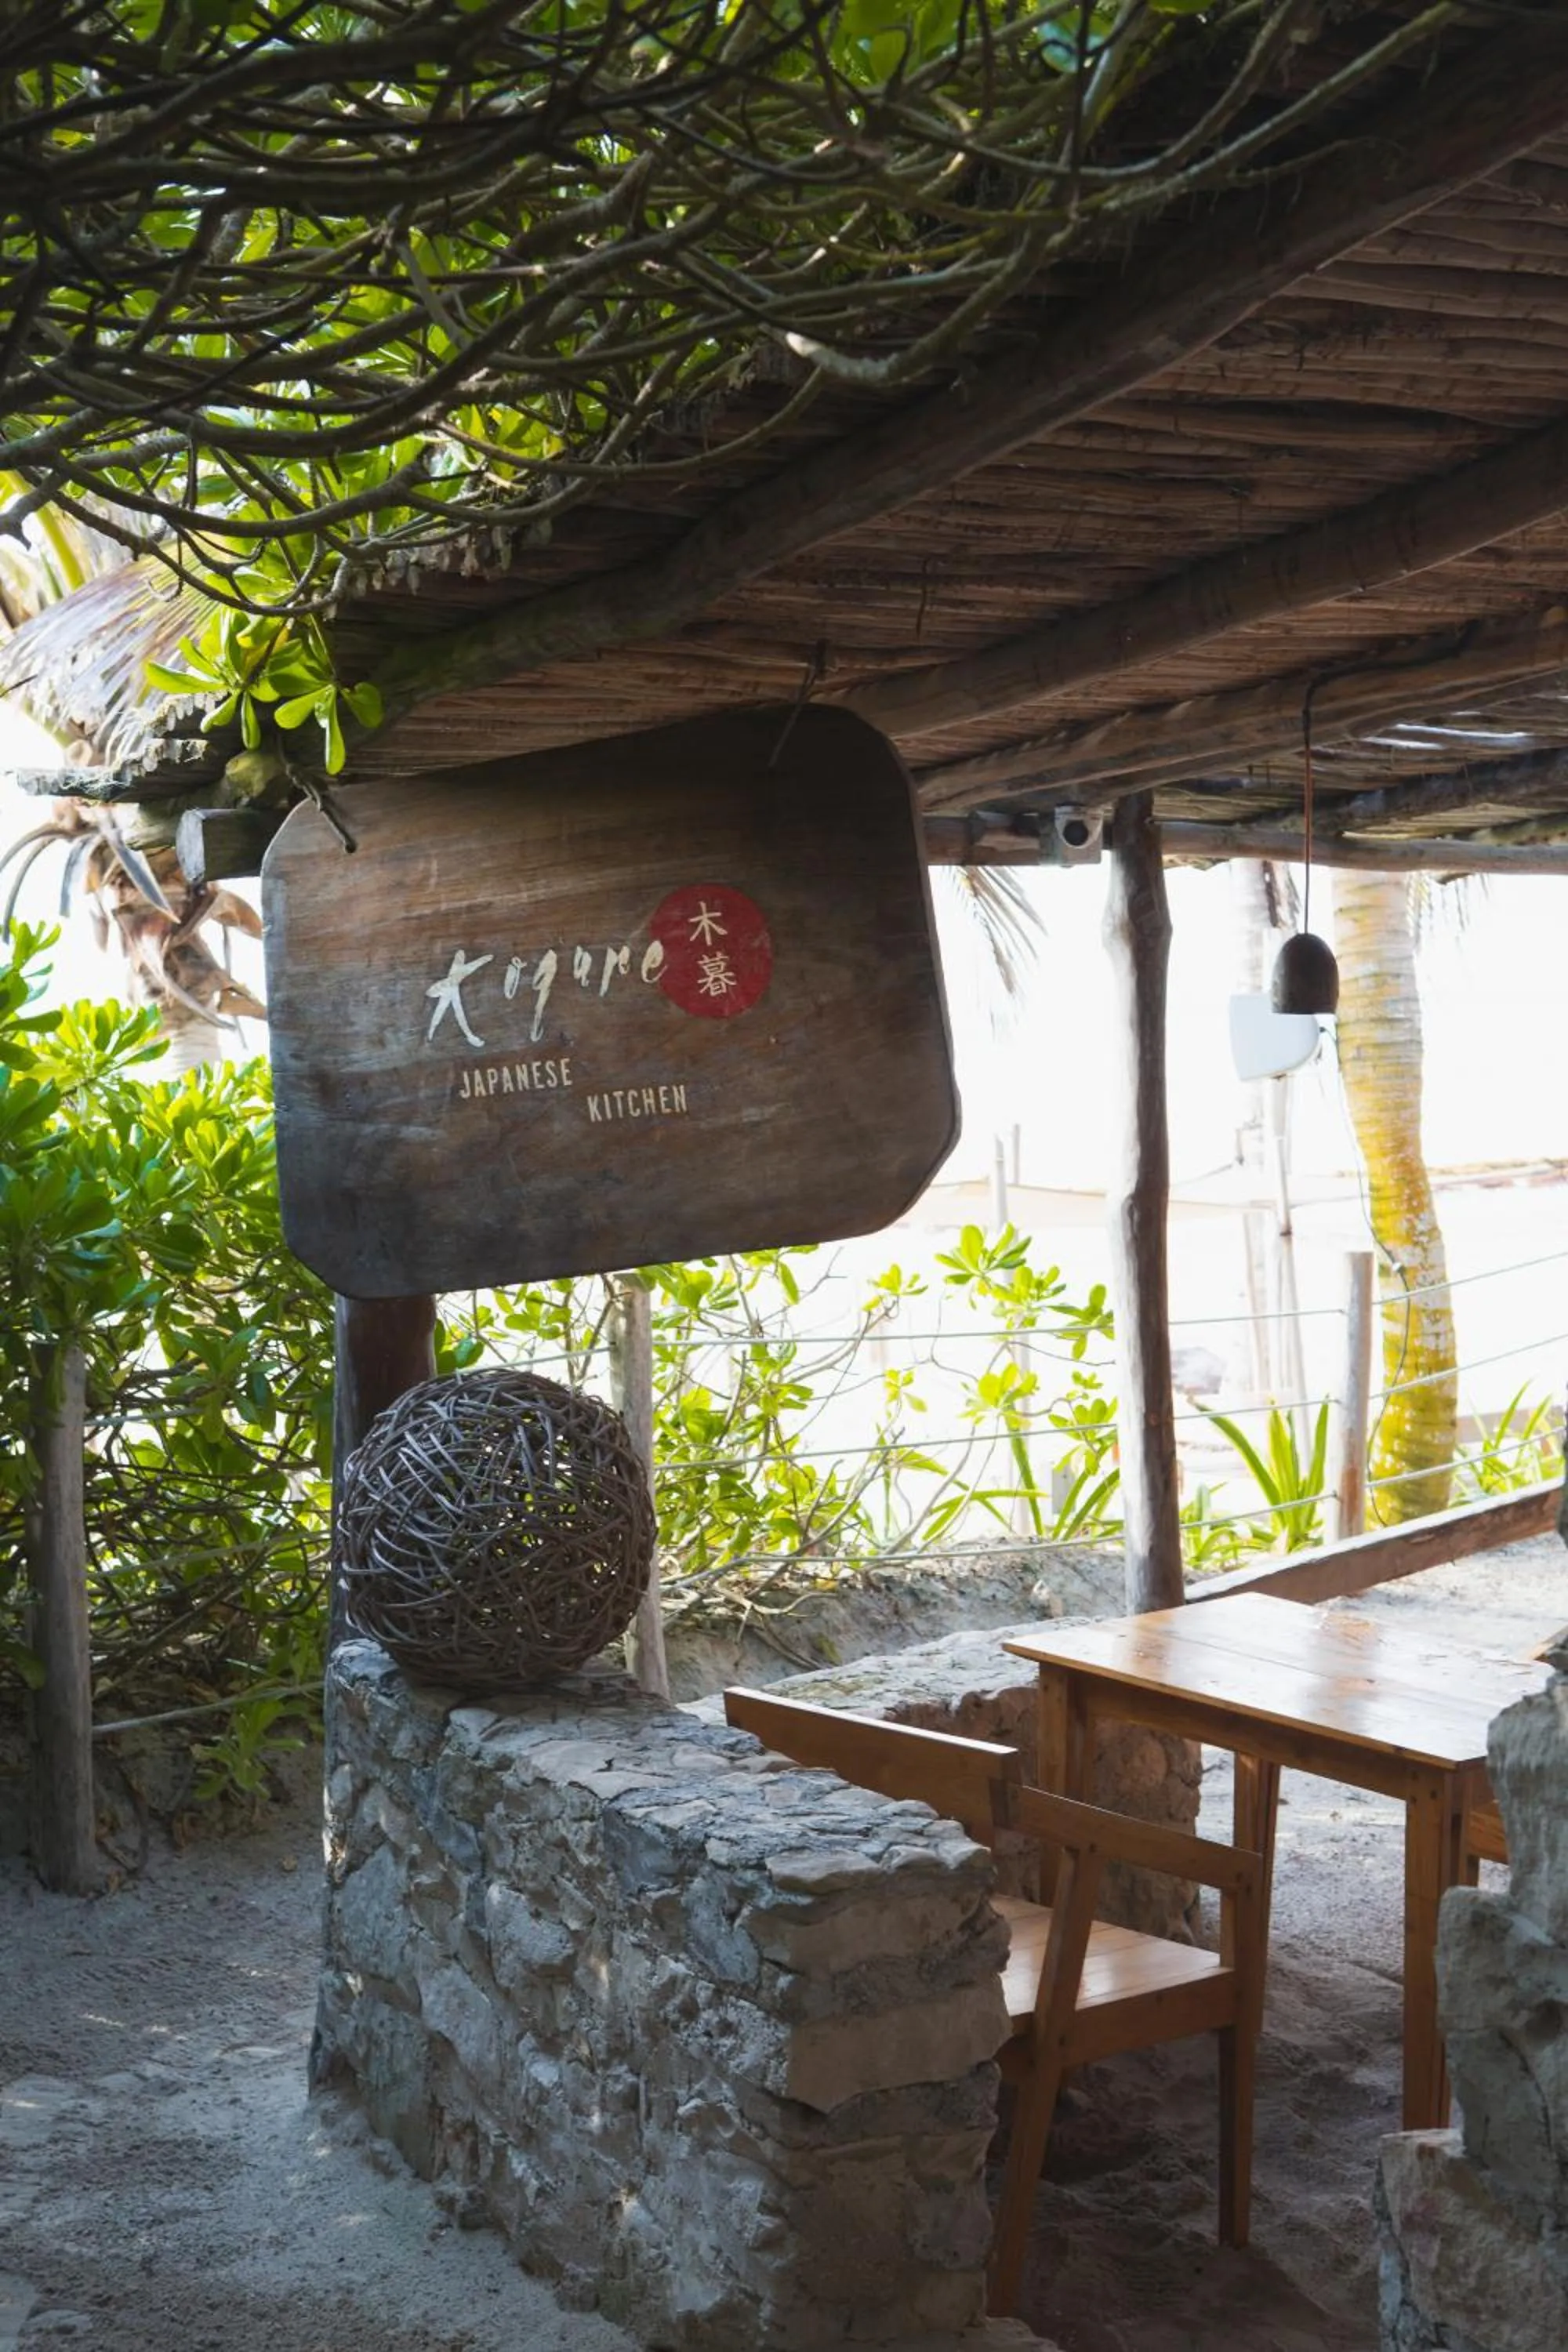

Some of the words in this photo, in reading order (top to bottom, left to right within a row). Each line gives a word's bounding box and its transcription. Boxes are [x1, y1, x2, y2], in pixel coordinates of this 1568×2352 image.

[688, 901, 737, 997] 木暮
[459, 1058, 573, 1099] JAPANESE
[587, 1085, 688, 1123] KITCHEN
